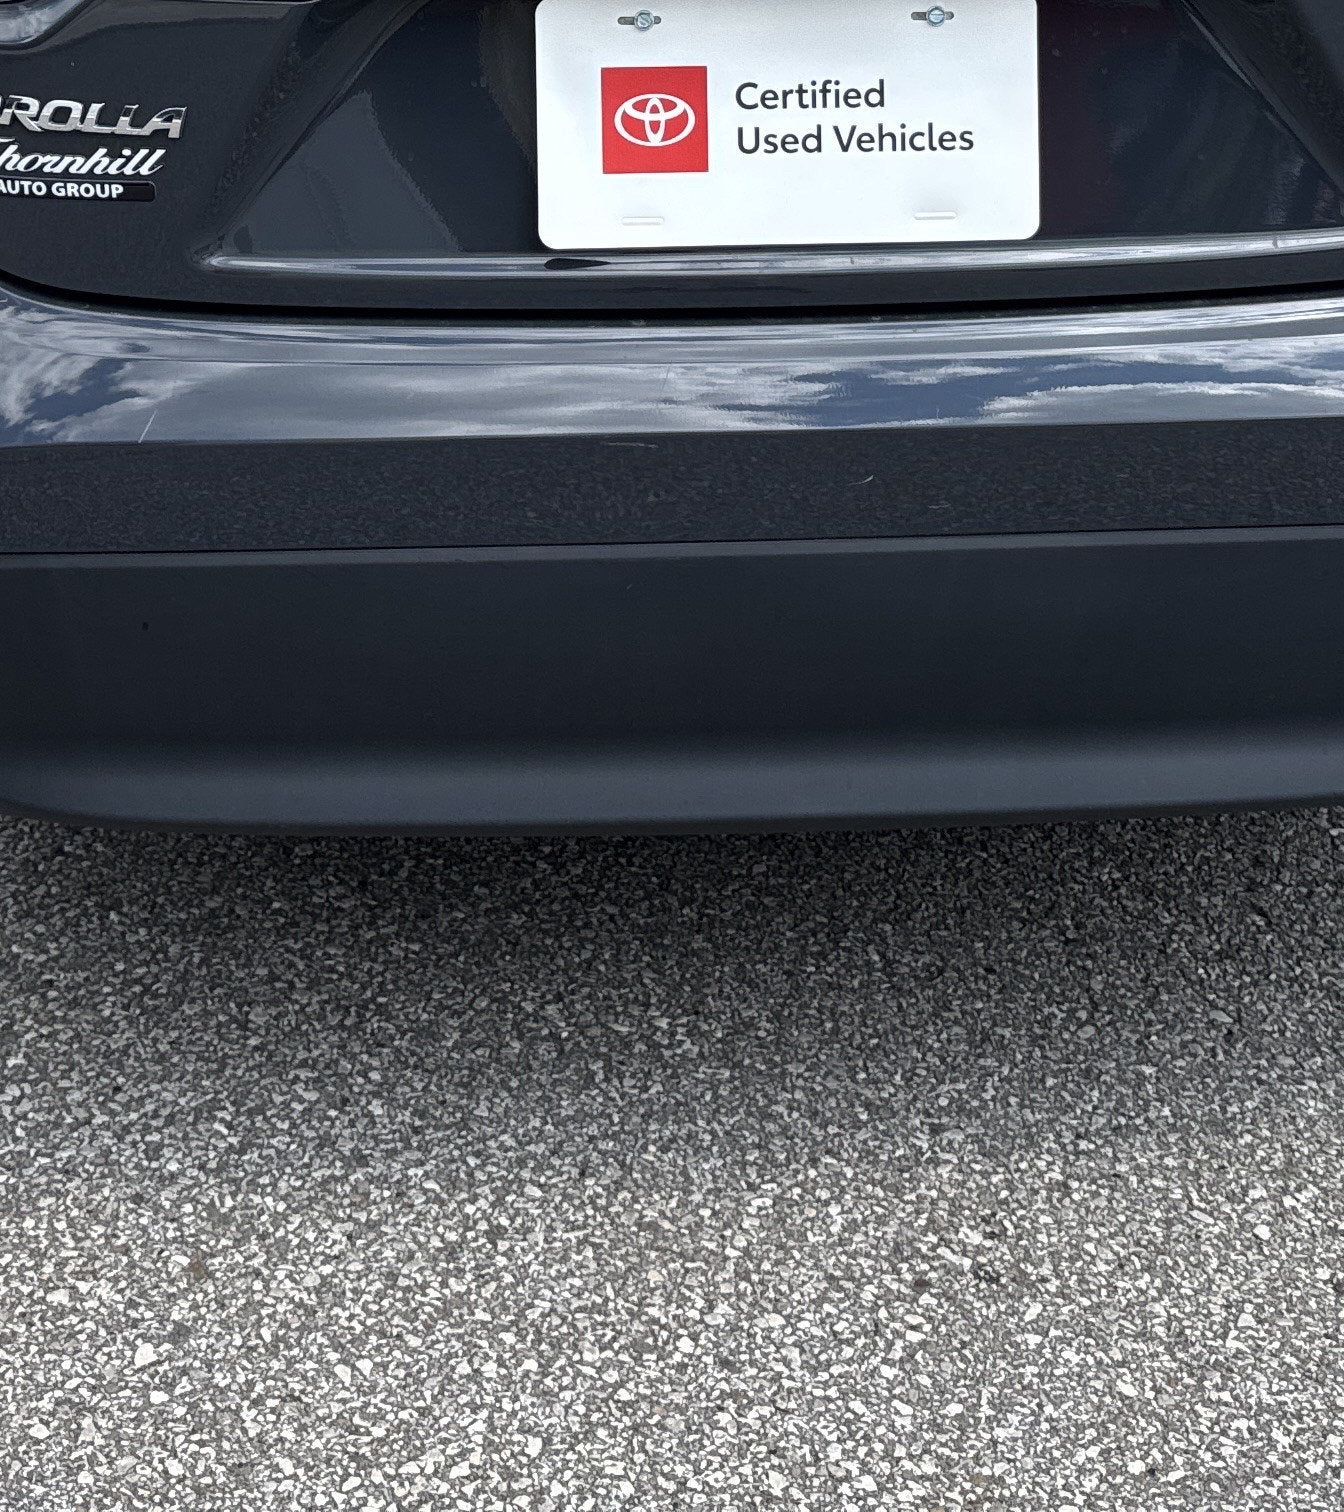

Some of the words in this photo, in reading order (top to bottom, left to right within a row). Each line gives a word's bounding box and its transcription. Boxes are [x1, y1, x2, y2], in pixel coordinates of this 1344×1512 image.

[735, 78, 886, 110] Certified
[737, 124, 823, 154] Used
[832, 122, 974, 153] Vehicles
[51, 181, 124, 199] GROUP
